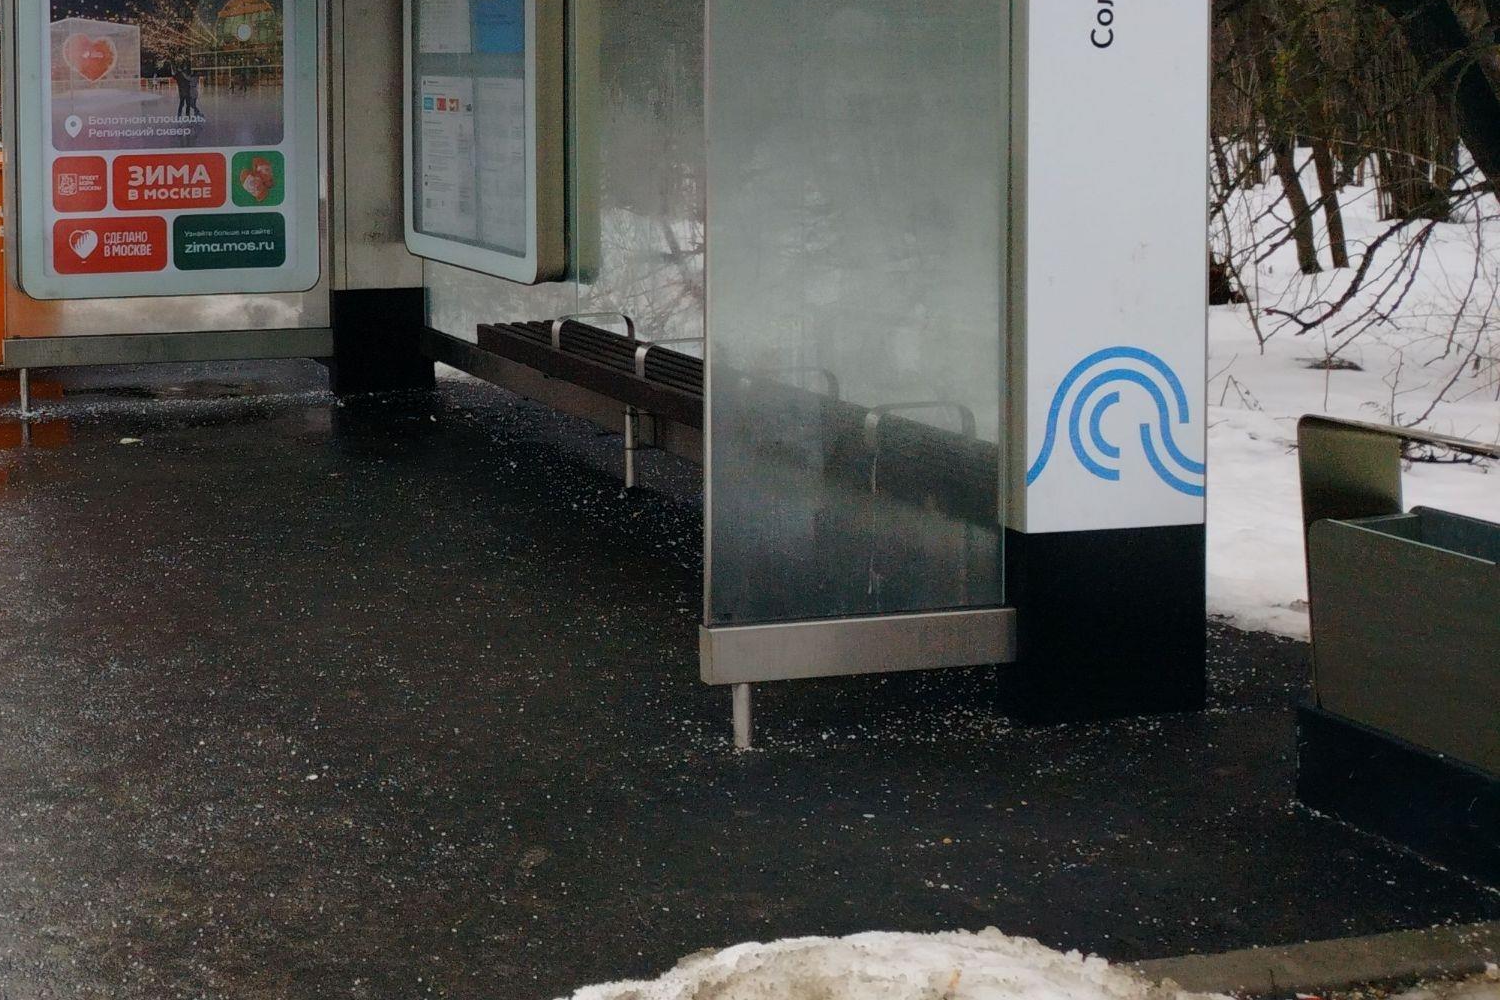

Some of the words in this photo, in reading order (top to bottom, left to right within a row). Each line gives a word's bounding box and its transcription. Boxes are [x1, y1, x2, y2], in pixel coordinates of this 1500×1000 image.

[88, 127, 154, 138] Репинский
[156, 127, 192, 137] сквер
[128, 164, 212, 186] ЗИМА
[128, 189, 139, 200] В
[144, 187, 212, 199] МОСКВЕ
[104, 231, 148, 244] СДЕЛАНО
[104, 245, 111, 257] В
[112, 244, 152, 256] МОСКВЕ
[184, 241, 275, 253] zima.mos.ru
